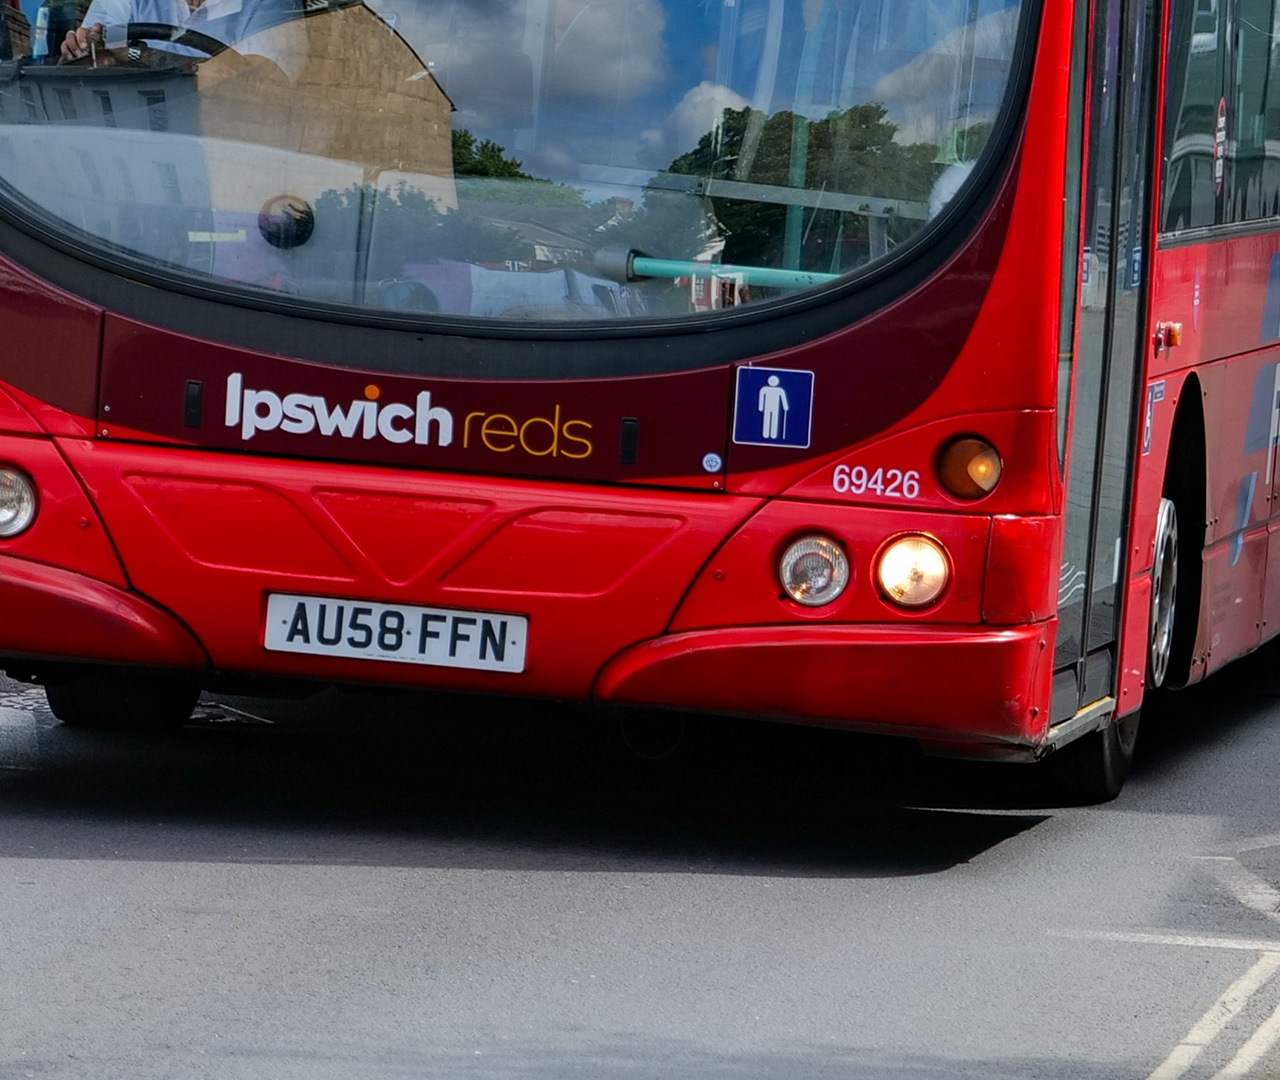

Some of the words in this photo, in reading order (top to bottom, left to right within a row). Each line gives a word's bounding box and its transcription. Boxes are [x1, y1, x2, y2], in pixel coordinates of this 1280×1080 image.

[225, 372, 453, 448] Ipswich
[463, 404, 593, 459] reds
[832, 464, 920, 498] 69426
[285, 602, 405, 652] AU58
[418, 613, 508, 662] FFN
